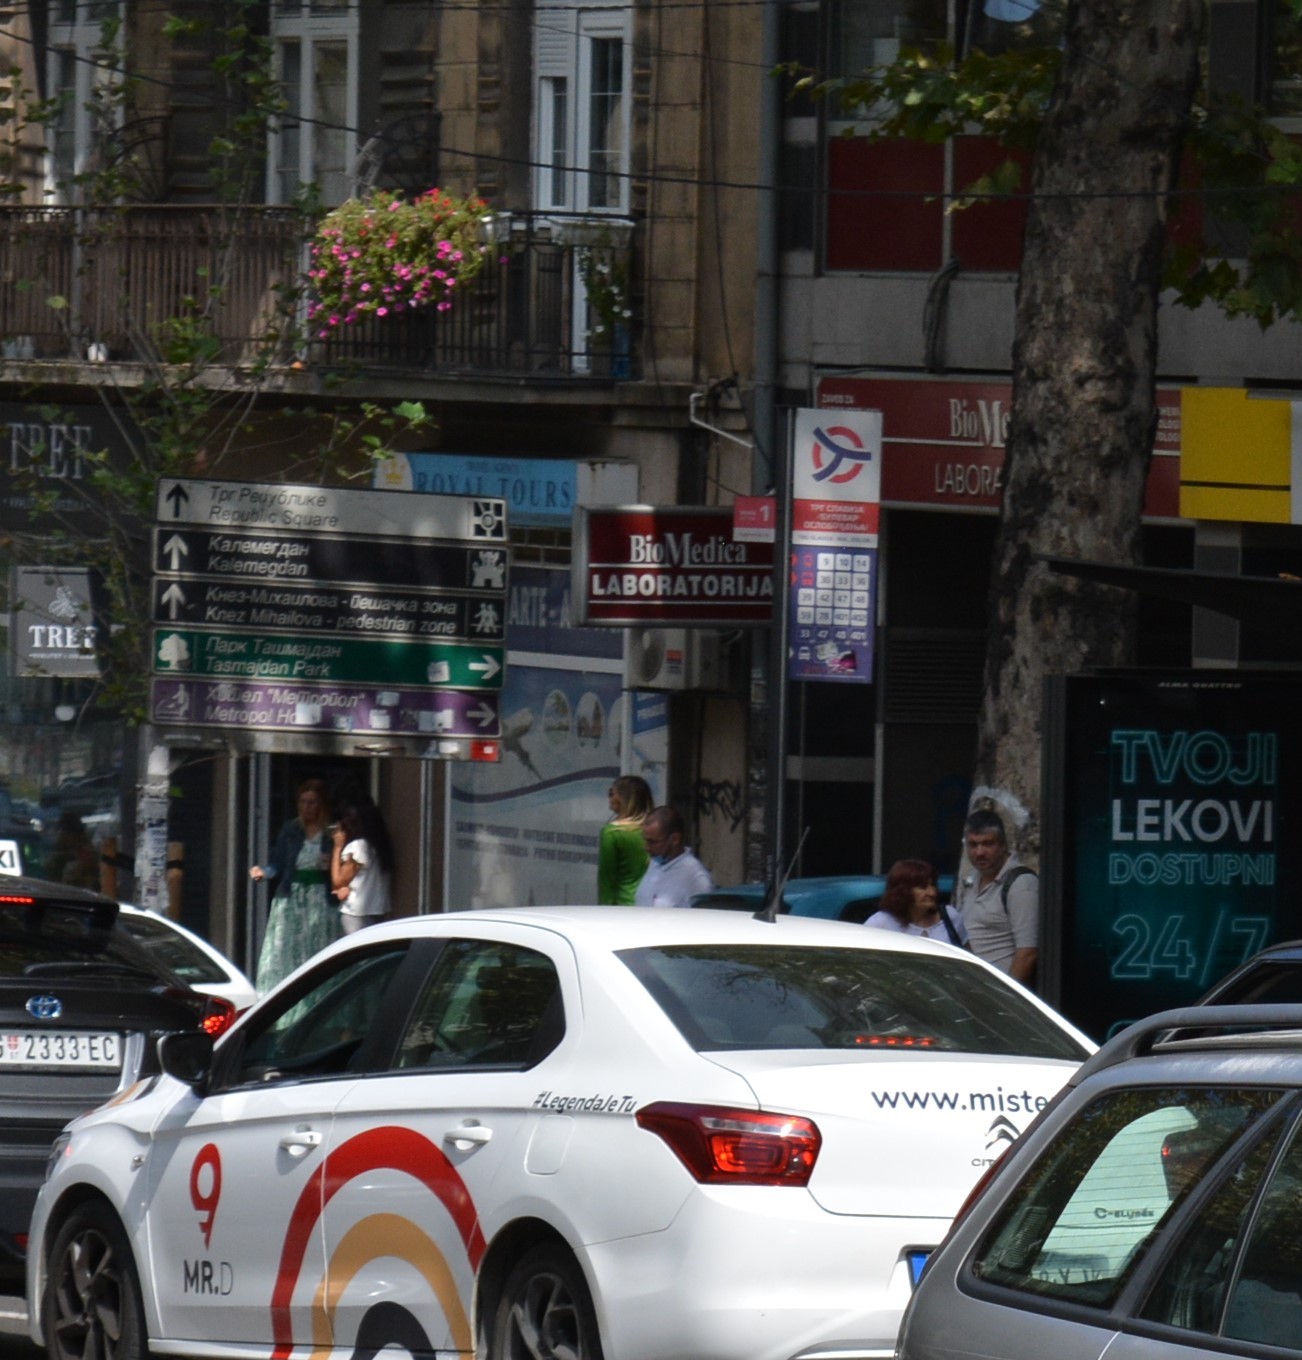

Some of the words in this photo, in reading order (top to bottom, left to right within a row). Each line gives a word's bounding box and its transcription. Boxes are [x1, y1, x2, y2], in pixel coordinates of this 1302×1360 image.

[949, 398, 1011, 447] BioMe
[499, 478, 571, 508] TOURS
[935, 463, 1003, 496] LABORA
[208, 505, 277, 524] Republic
[281, 509, 340, 529] Square
[207, 535, 311, 558] Калемегдан
[629, 532, 747, 567] BioMedica
[207, 555, 309, 579] Kalemegdan
[591, 573, 774, 597] LABORATORIJA
[205, 605, 246, 623] Knez
[249, 607, 322, 627] Mihailova
[336, 613, 415, 633] pedestrian
[419, 620, 457, 634] zone
[205, 636, 248, 655] Парк
[206, 656, 289, 679] Tasmajdan
[292, 660, 331, 677] Park
[205, 705, 273, 725] Metropol
[1111, 730, 1278, 786] TVOJI
[1111, 799, 1273, 842] LEKOVI
[1108, 853, 1275, 886] DOSTUPNI
[1111, 902, 1269, 988] 24/7
[533, 1090, 638, 1114] #LegendaJeTu
[871, 1086, 1049, 1114] www.miste
[183, 1259, 234, 1297] MR.D
